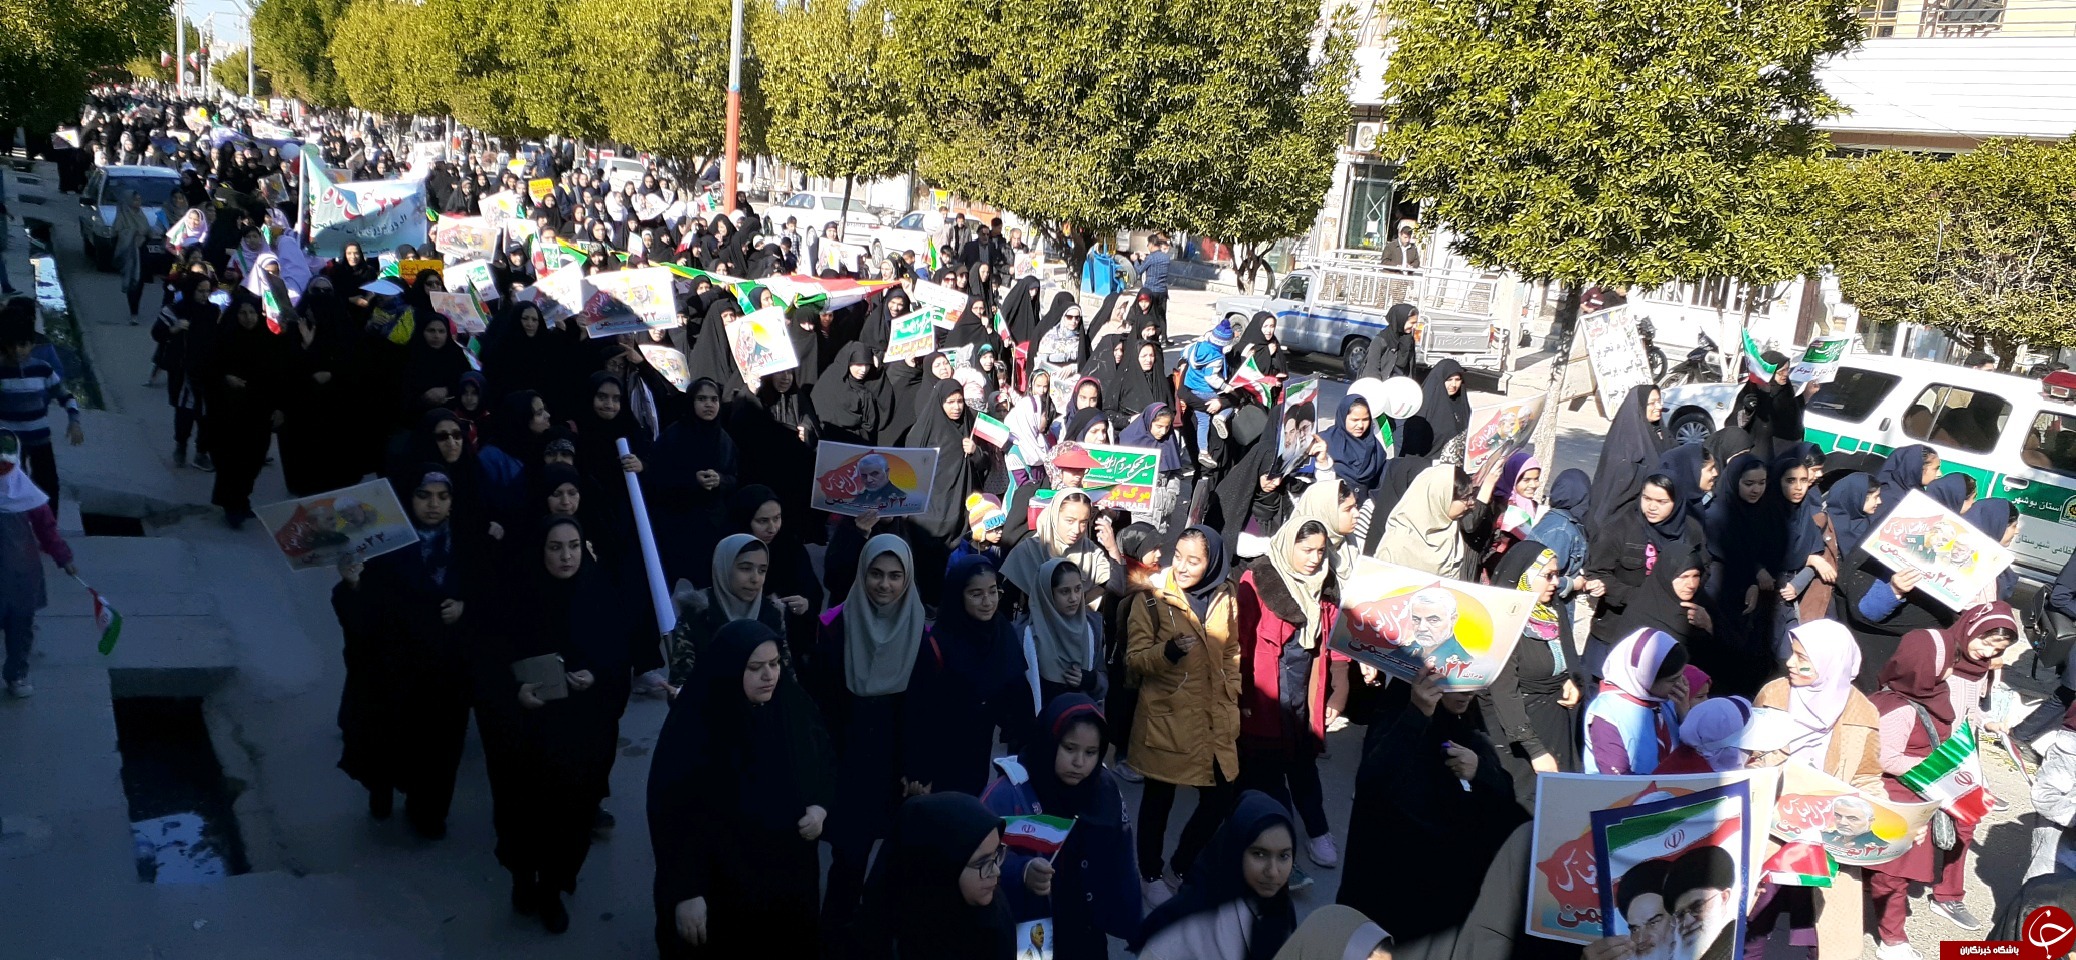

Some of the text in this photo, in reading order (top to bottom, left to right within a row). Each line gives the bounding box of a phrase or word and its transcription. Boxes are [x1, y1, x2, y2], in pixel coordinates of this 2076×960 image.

[1433, 333, 1476, 346] mazda
[888, 496, 907, 508] ۲۲
[1108, 487, 1151, 503] مرگ بر
[825, 498, 889, 511] بهمن
[1116, 501, 1149, 511] ISRAEL
[2011, 496, 2063, 512] استان بوشهر
[2014, 533, 2051, 550] شهرستان
[1933, 571, 1955, 588] ۲۲
[1444, 660, 1473, 679] ۲۲
[1863, 843, 1890, 857] ۲۲
